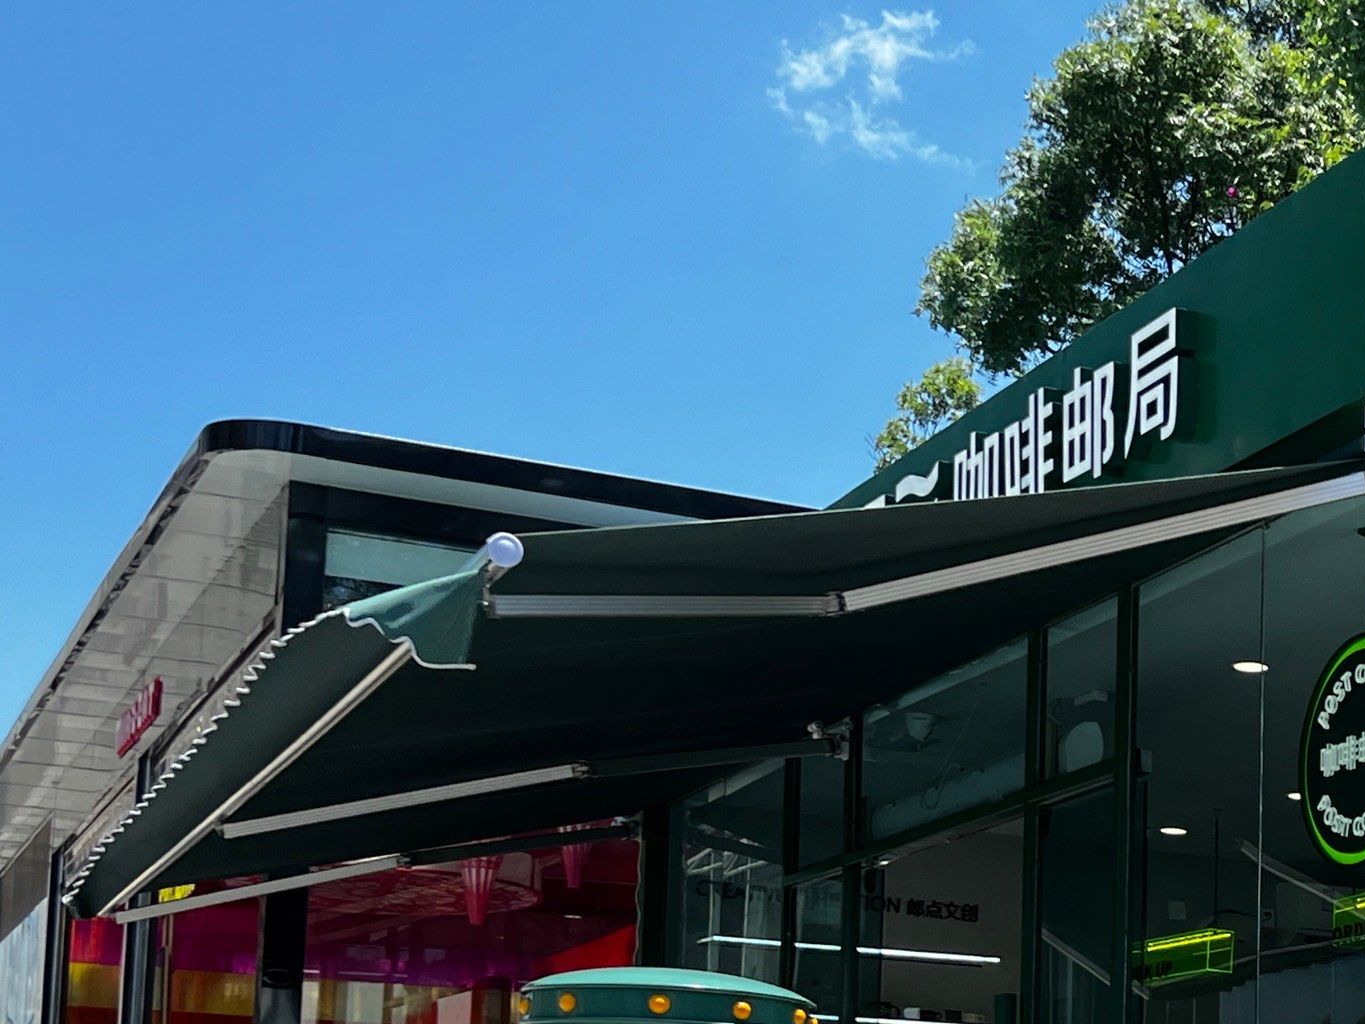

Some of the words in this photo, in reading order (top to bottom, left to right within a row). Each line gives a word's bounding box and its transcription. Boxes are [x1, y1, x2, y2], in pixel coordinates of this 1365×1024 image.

[952, 307, 1179, 503] 咖啡邮局
[1317, 671, 1352, 730] POST
[1316, 794, 1351, 838] POST
